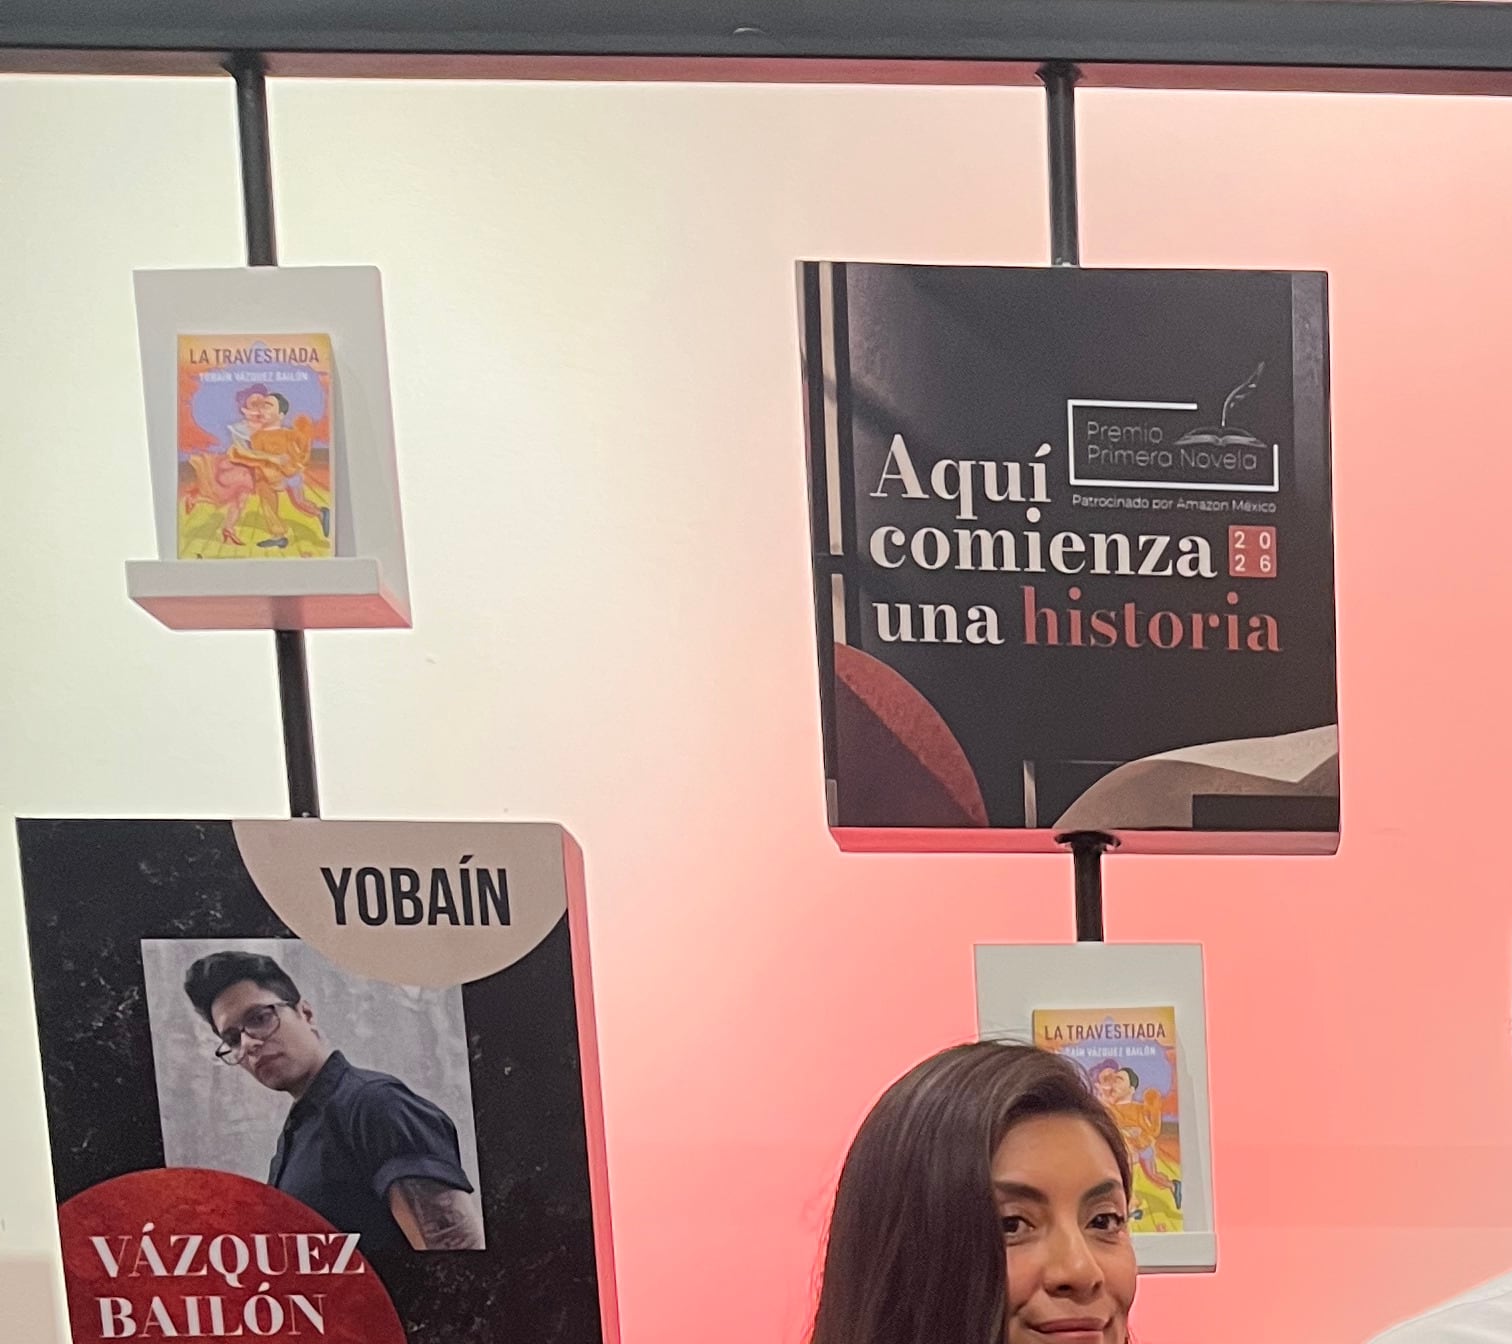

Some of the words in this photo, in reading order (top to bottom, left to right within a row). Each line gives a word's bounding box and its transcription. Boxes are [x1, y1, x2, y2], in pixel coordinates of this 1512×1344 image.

[190, 348, 209, 364] LA
[213, 348, 319, 364] TRAVESTIADA
[1087, 421, 1163, 443] Premio
[1088, 445, 1172, 467] Primera
[1181, 449, 1257, 470] Novela
[870, 433, 1051, 520] Aquí
[1073, 494, 1148, 509] Patrocinado
[1153, 499, 1173, 510] por
[1177, 498, 1229, 511] Amazon
[1233, 499, 1276, 512] México
[870, 506, 1217, 578] comienza
[872, 599, 1005, 645] una
[1022, 586, 1283, 653] historia
[320, 855, 511, 927] YOBAÍN
[1045, 1025, 1063, 1040] LA
[1066, 1024, 1165, 1040] TRAVESTIADA
[90, 1222, 366, 1290] VÁZQUEZ
[98, 1282, 325, 1339] BAILÓN
